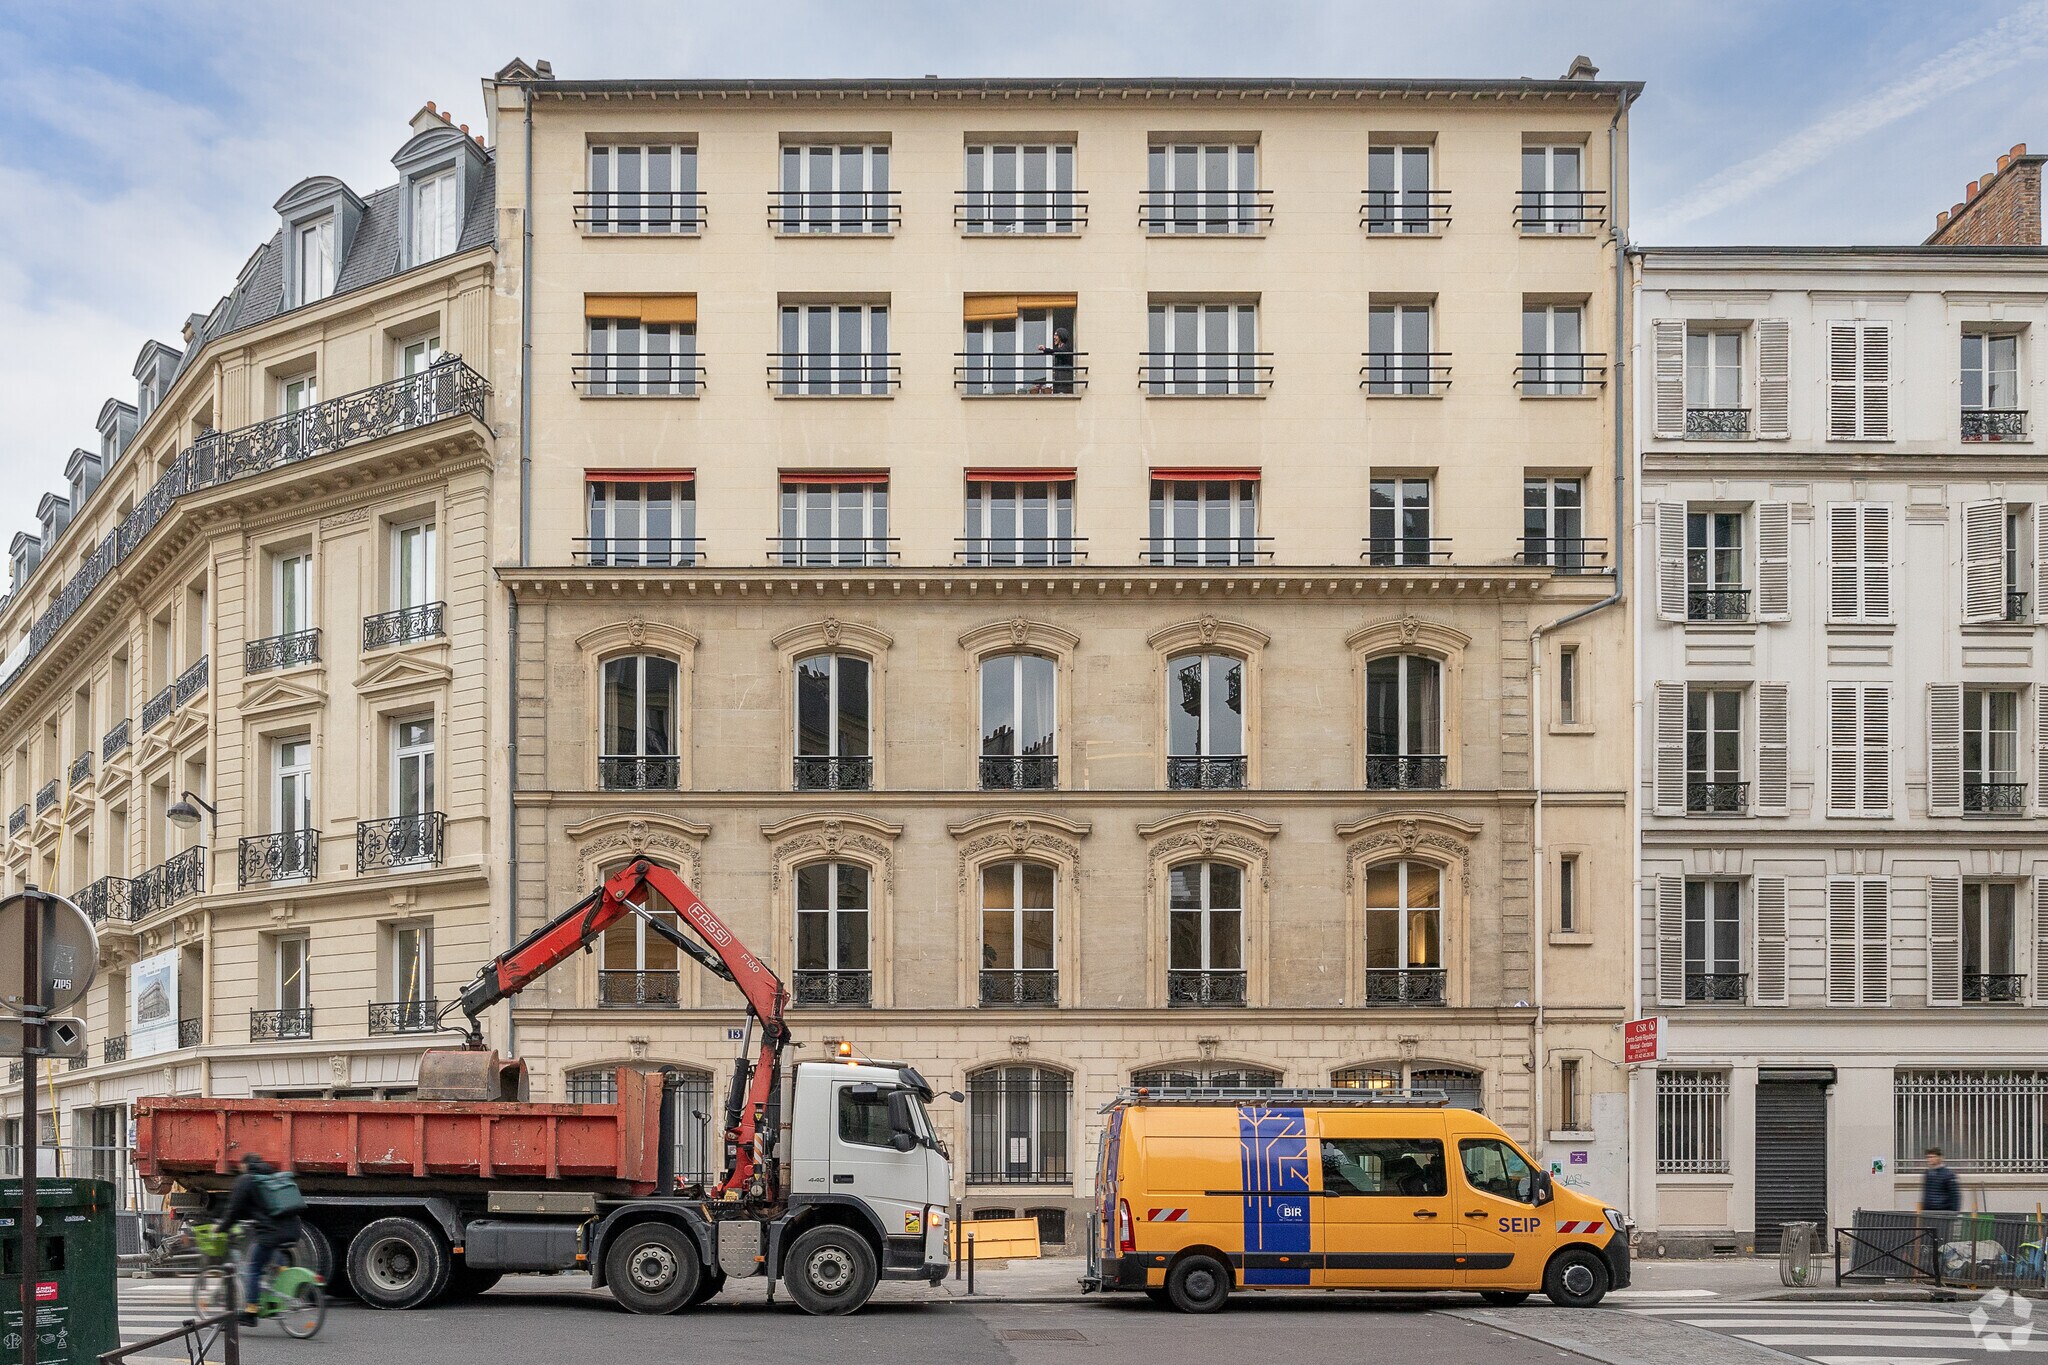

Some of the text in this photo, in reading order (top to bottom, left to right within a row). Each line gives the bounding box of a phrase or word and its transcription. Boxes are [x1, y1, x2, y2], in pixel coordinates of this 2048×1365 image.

[691, 905, 729, 944] FASSI
[740, 953, 760, 973] F150
[53, 979, 71, 989] ZIPS
[1636, 1024, 1646, 1033] CSR
[730, 1029, 741, 1039] 13
[1284, 1208, 1302, 1217] BIR
[1499, 1217, 1541, 1233] SEIP
